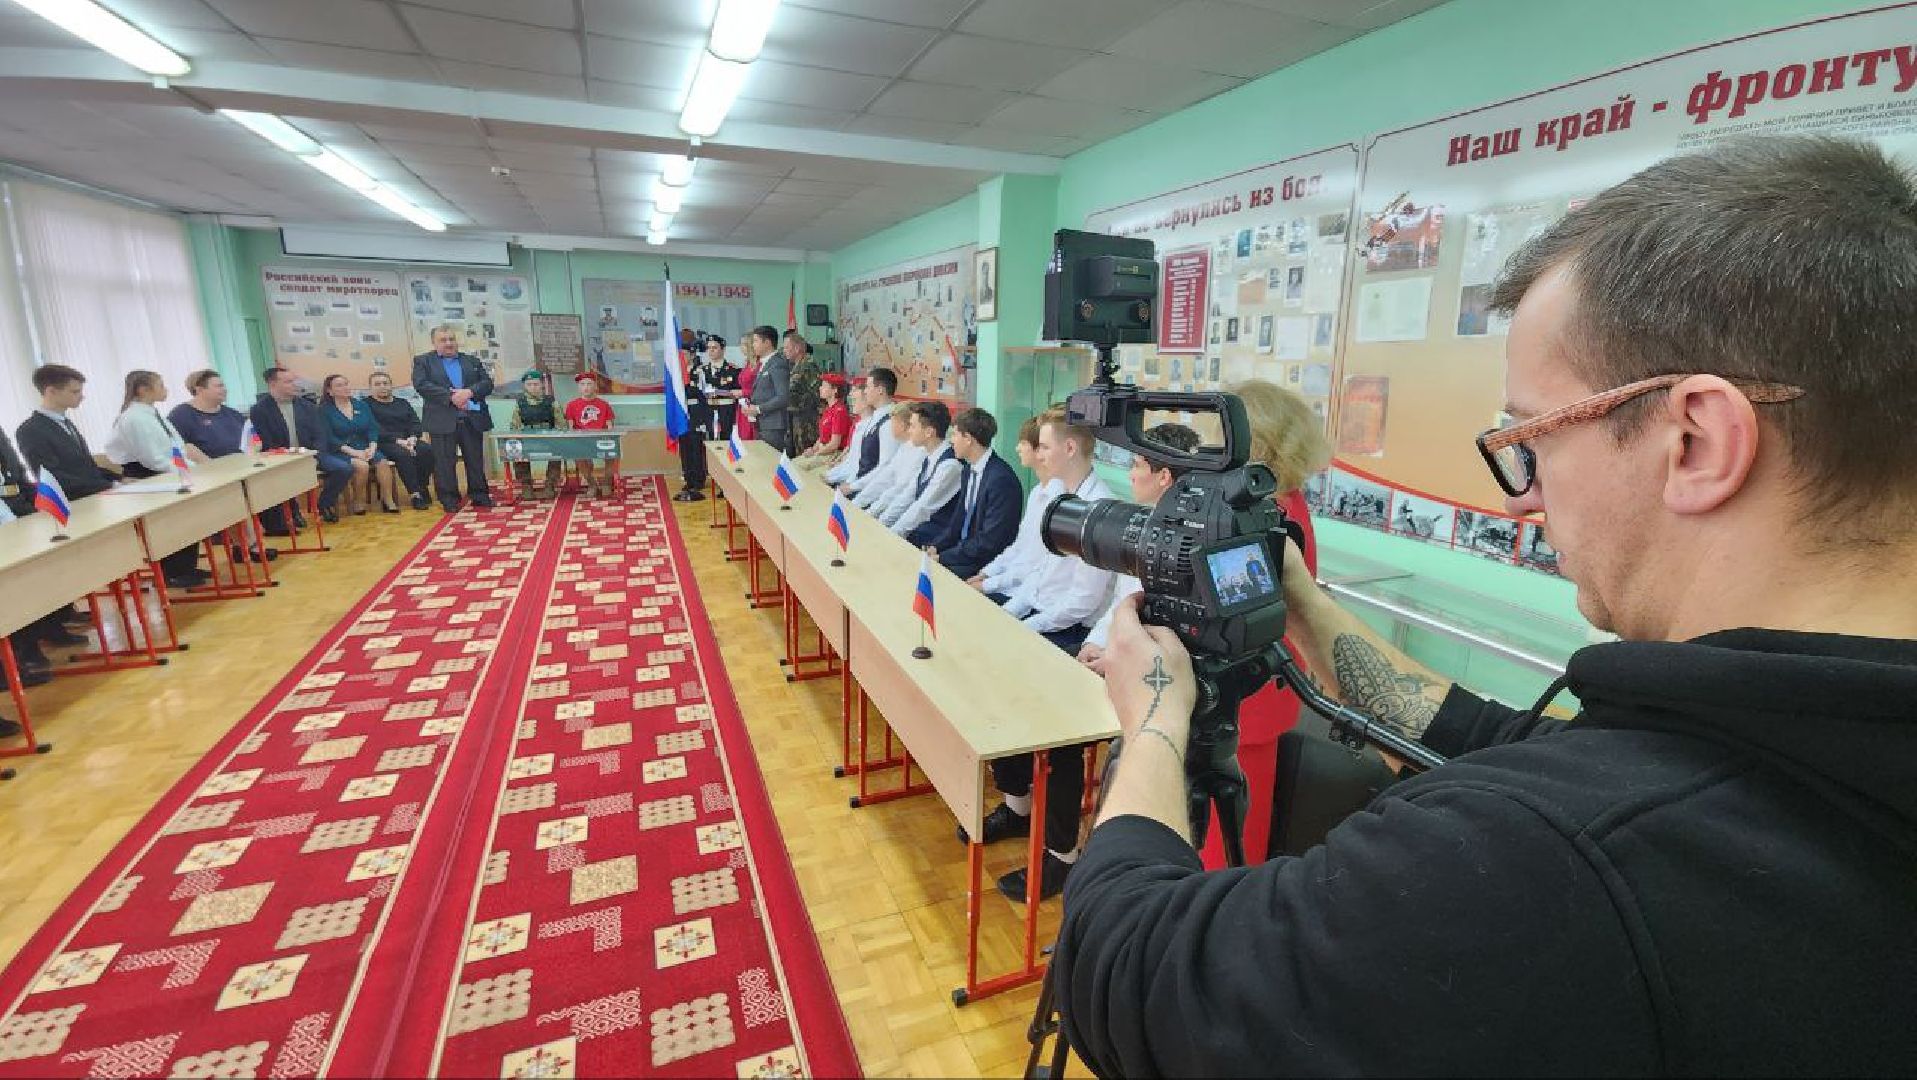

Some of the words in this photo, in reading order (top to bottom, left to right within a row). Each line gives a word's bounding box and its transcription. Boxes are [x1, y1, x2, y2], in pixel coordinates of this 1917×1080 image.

[1447, 128, 1522, 166] Наш
[1535, 94, 1636, 151] край
[1686, 45, 1917, 124] фронту
[1249, 187, 1274, 209] из
[265, 271, 339, 284] Российский
